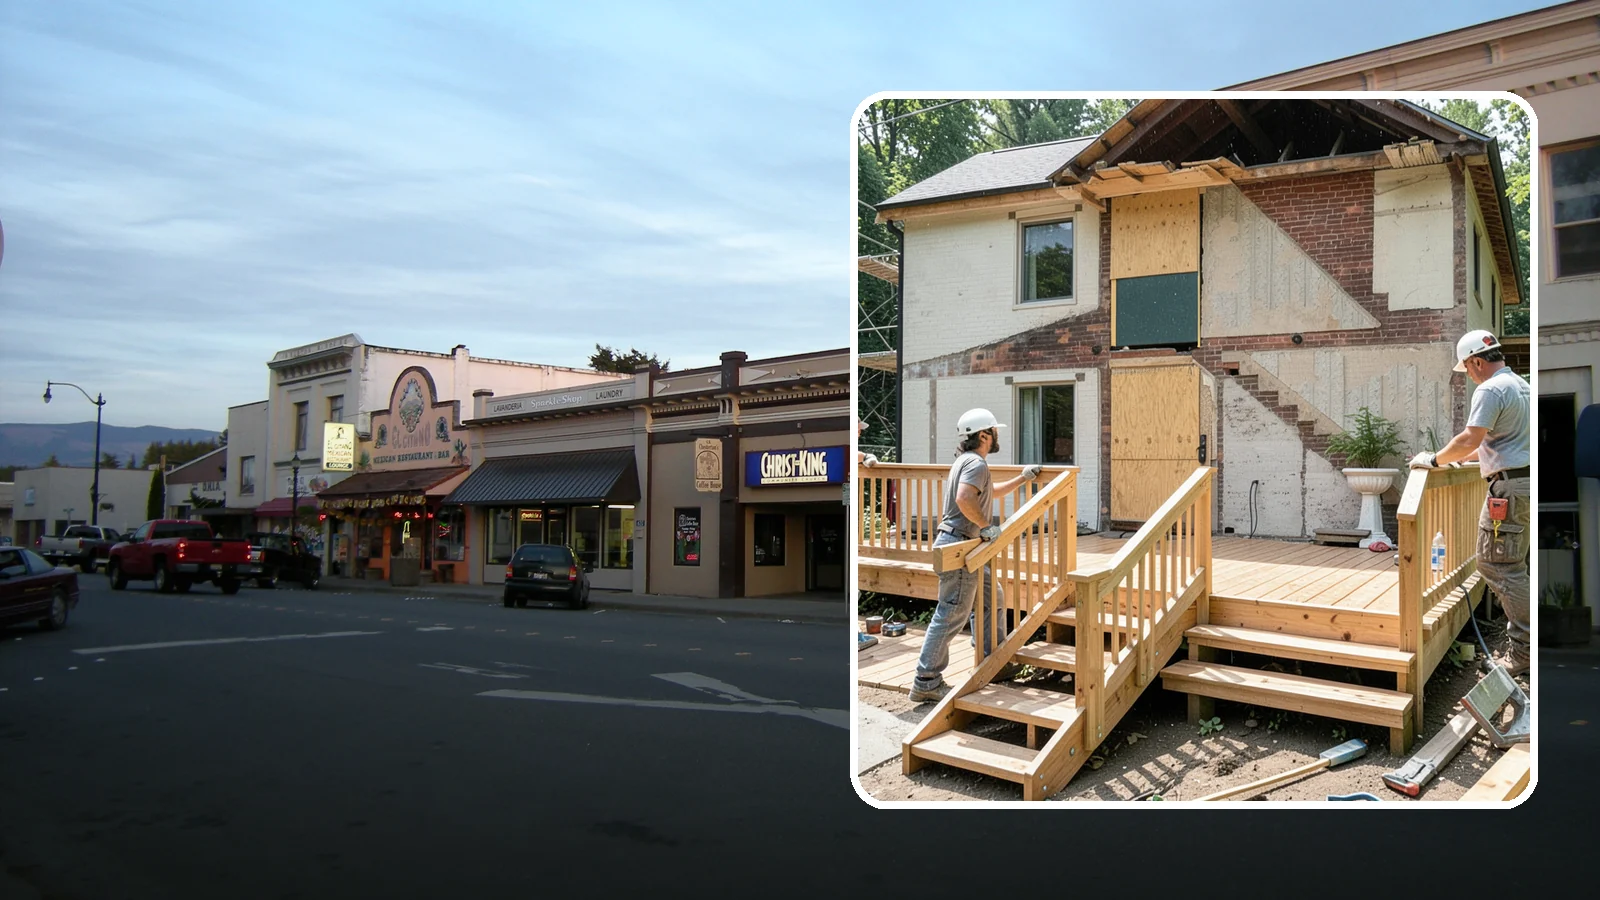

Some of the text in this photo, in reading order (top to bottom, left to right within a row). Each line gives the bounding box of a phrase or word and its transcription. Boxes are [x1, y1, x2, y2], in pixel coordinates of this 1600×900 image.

[562, 394, 582, 406] Shop
[596, 389, 623, 400] LAUNDRY
[493, 402, 522, 412] LAVANDERIA
[391, 425, 402, 449] EL
[373, 454, 396, 464] MEXICAN
[397, 451, 434, 462] RESTAURANT
[438, 450, 450, 459] BAR
[761, 450, 827, 478] CHRIST KING
